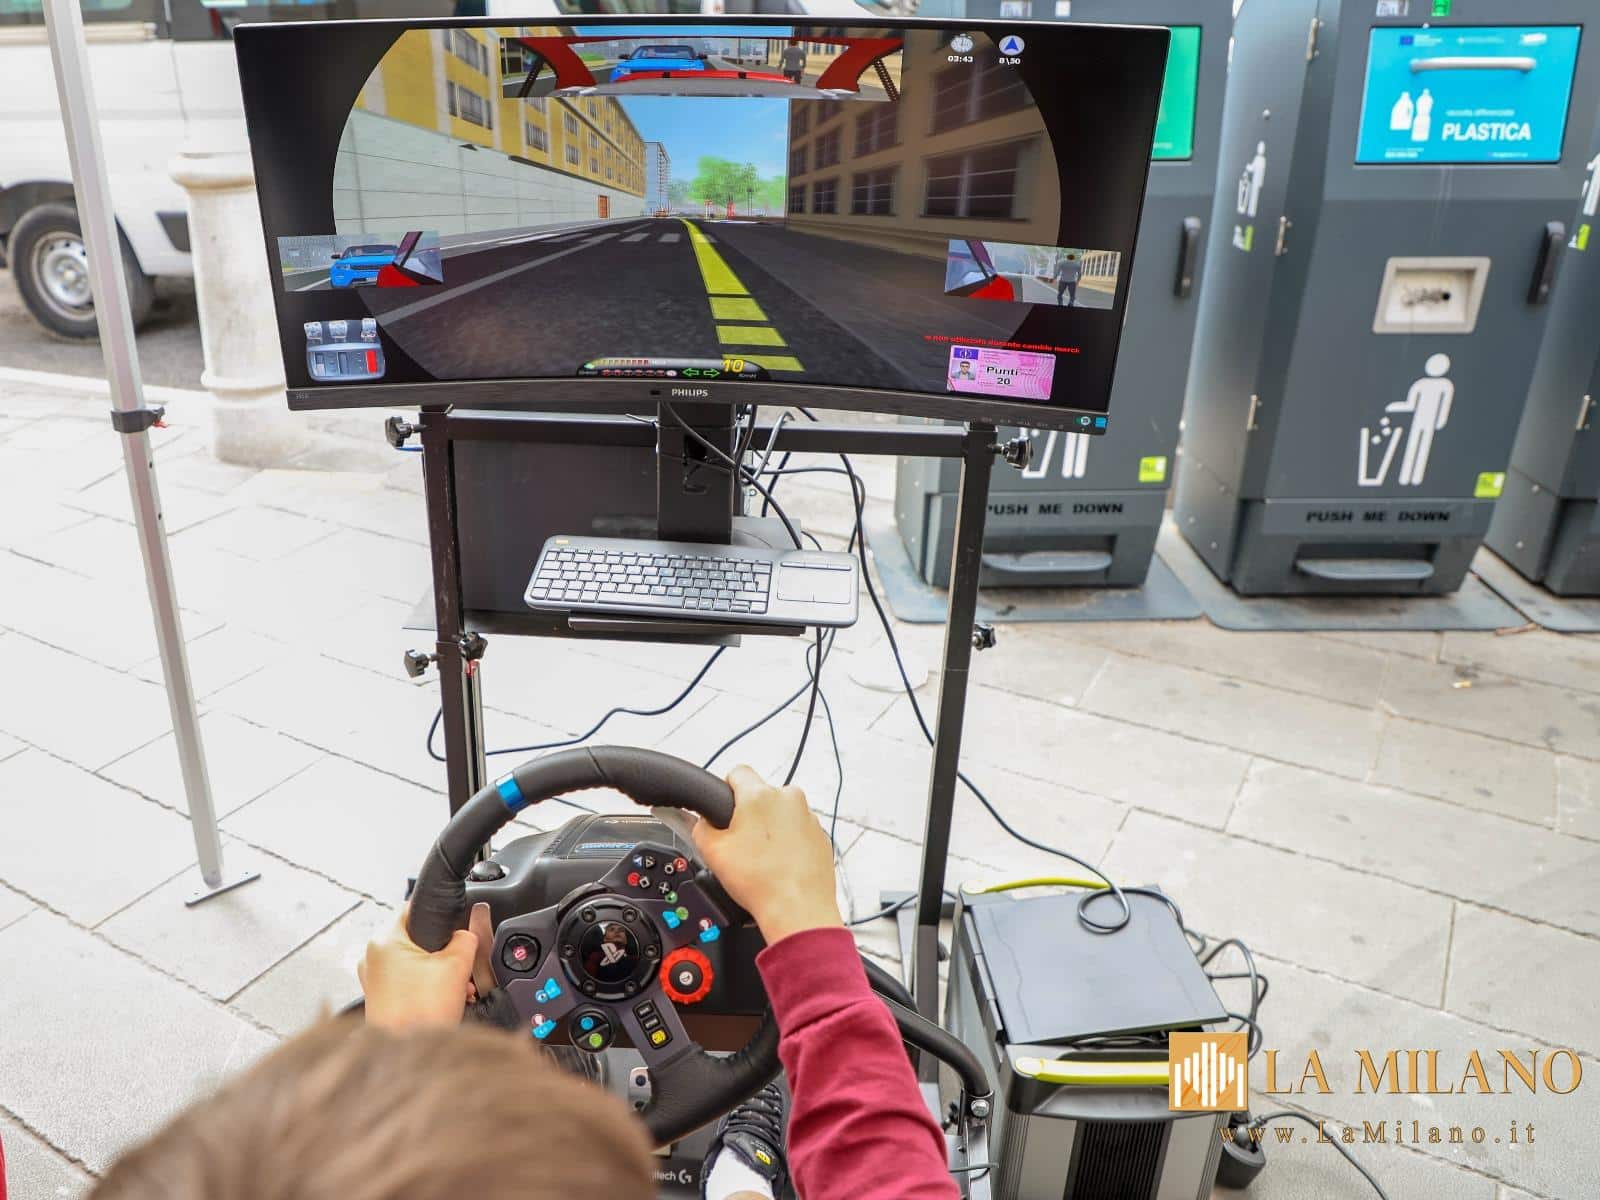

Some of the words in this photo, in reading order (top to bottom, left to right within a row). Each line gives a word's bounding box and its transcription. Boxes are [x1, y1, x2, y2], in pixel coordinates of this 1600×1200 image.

[947, 55, 974, 64] 03:43
[1441, 122, 1532, 141] PLASTICA
[722, 359, 745, 373] 10
[986, 365, 1018, 377] Punti
[997, 377, 1011, 386] 20
[671, 388, 709, 398] PHILIPS
[988, 503, 1028, 515] USH
[1039, 503, 1062, 514] ME
[1073, 503, 1124, 514] DOWN
[1306, 511, 1352, 523] PUSH
[1363, 511, 1385, 522] ME
[1397, 511, 1450, 522] DOWN
